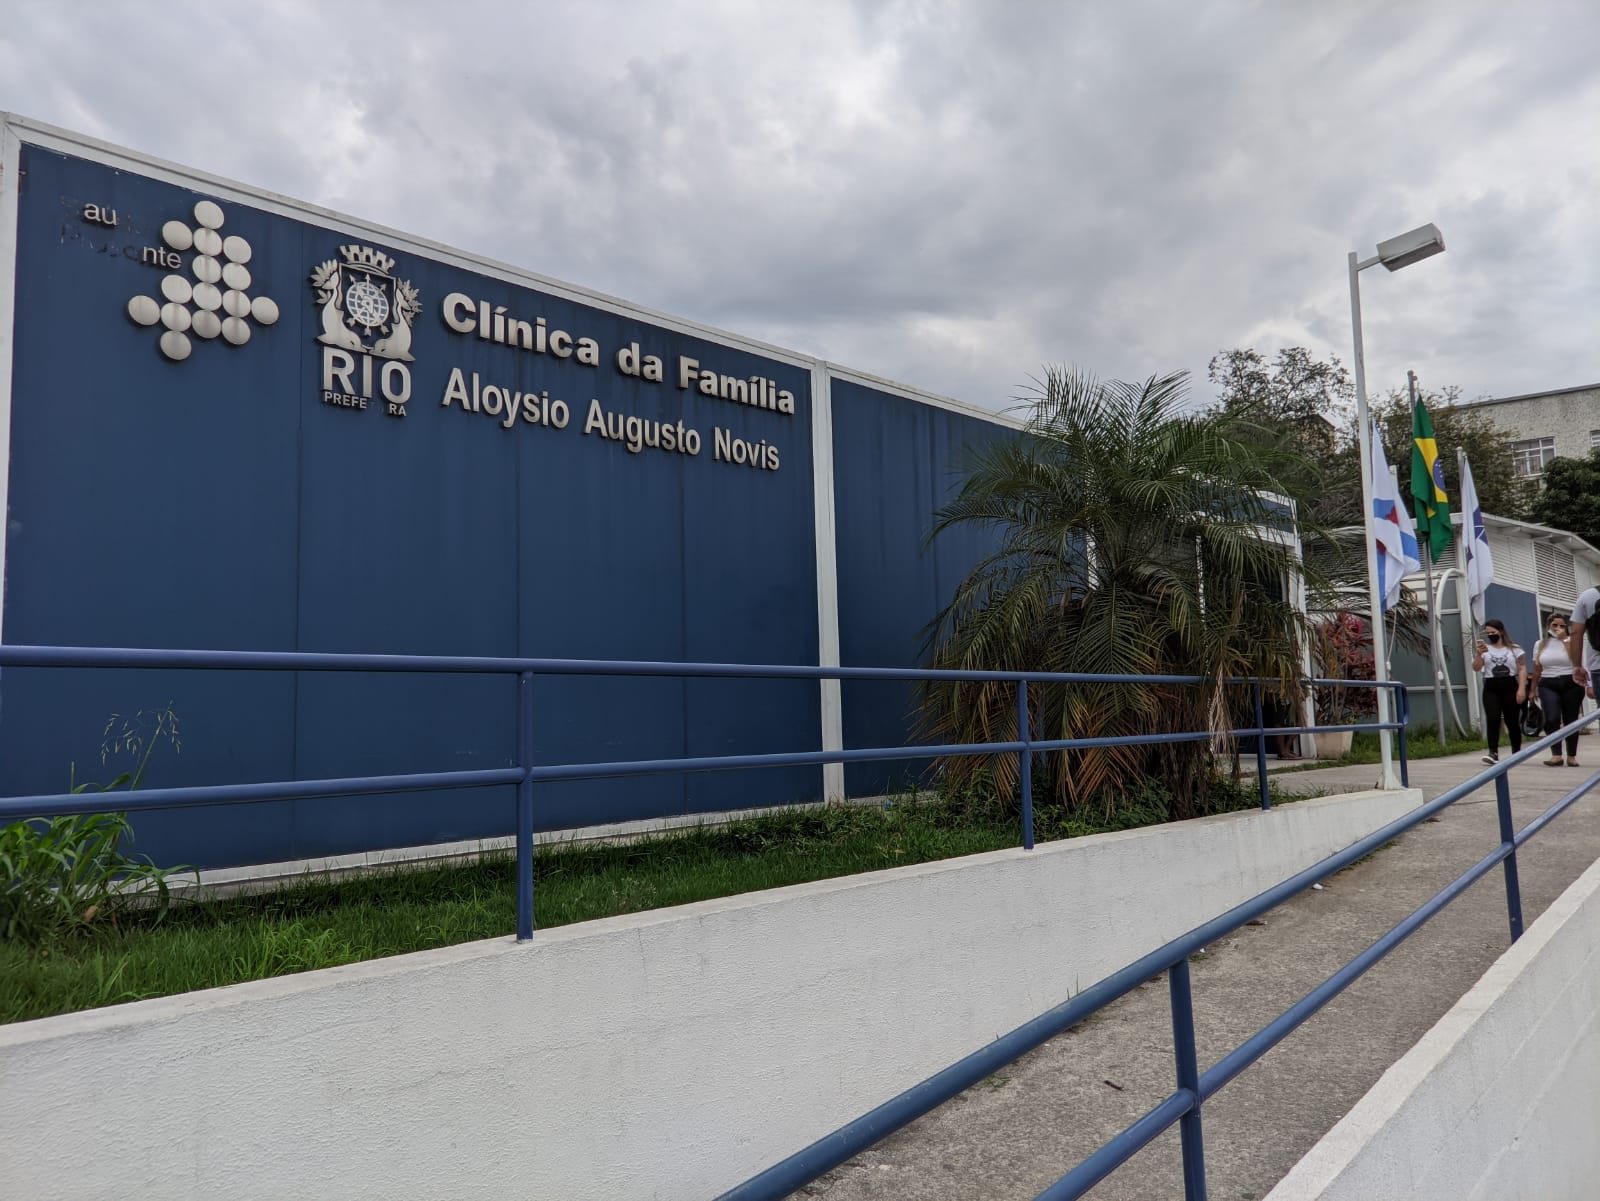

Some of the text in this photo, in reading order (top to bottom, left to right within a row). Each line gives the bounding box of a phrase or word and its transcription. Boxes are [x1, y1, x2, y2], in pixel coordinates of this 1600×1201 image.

[323, 346, 411, 404] RIO
[442, 292, 795, 414] Clínica da Família
[442, 367, 780, 470] Aloysio Augusto Novis
